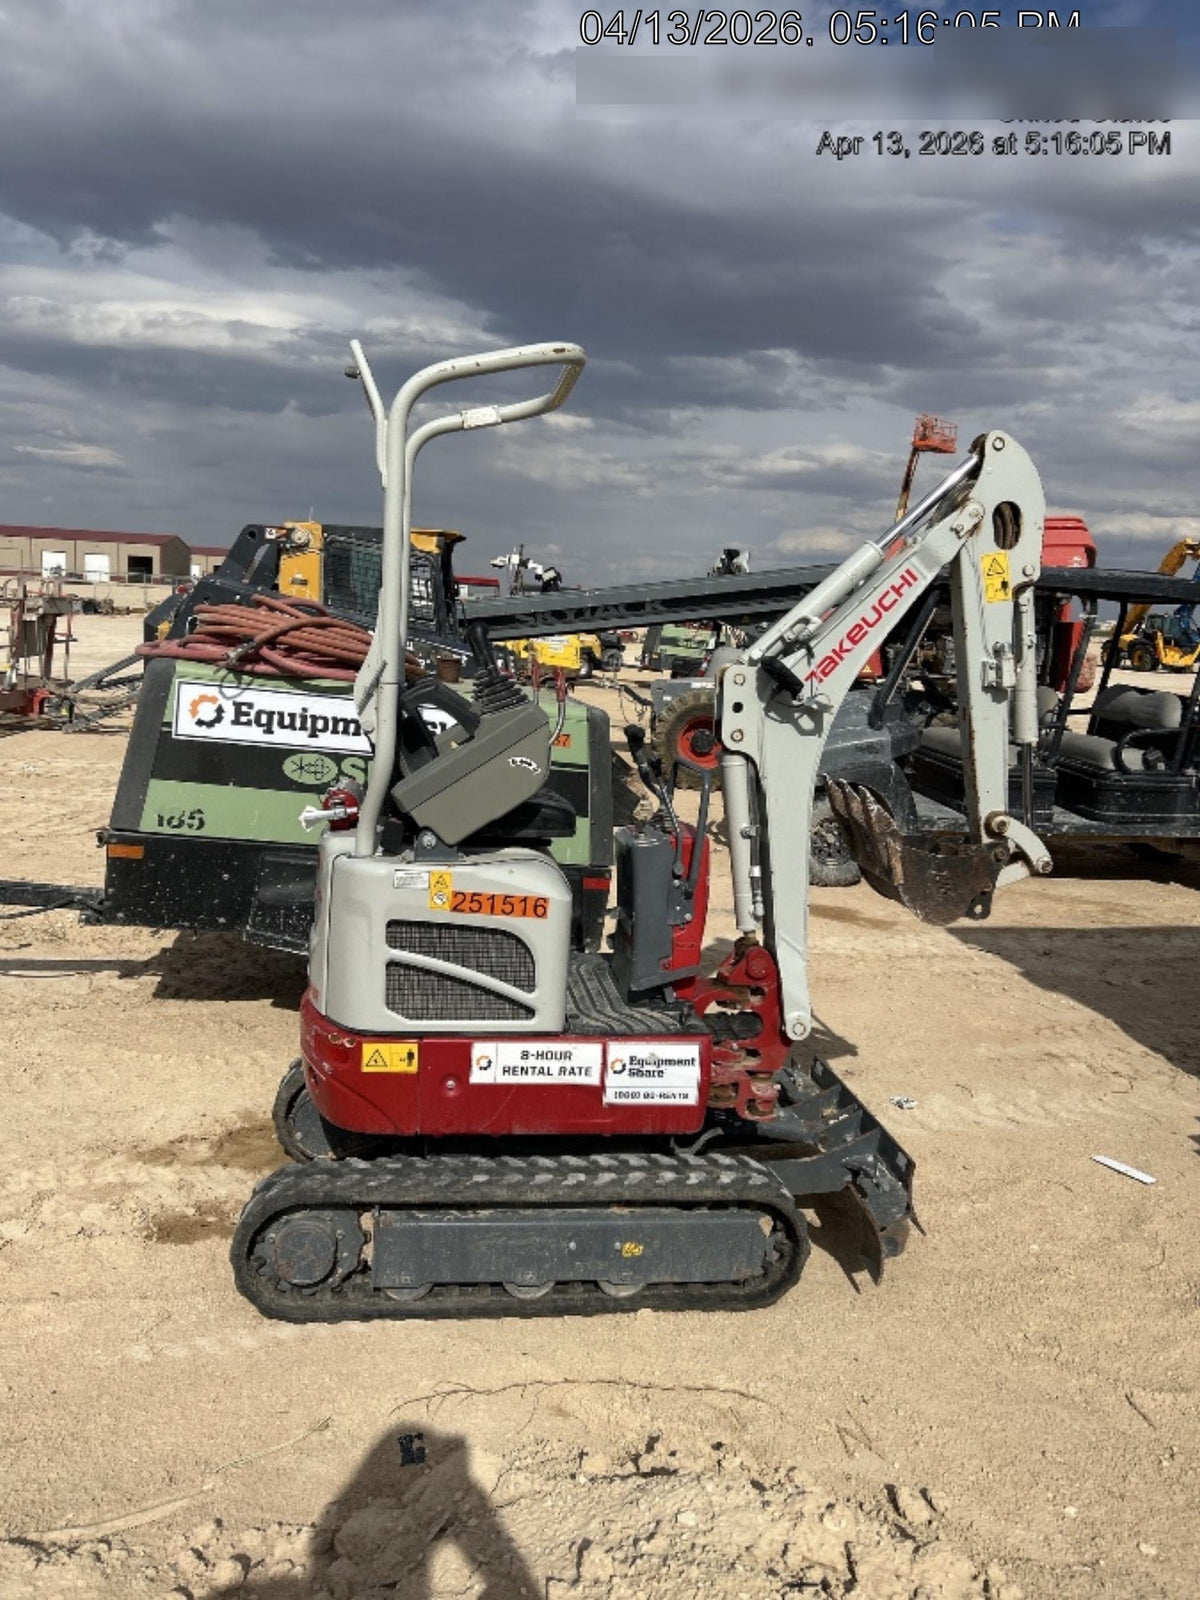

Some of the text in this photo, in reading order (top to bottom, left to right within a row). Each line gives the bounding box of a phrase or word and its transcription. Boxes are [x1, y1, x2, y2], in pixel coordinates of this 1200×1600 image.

[452, 891, 548, 918] 251516
[520, 1050, 573, 1061] 8-HOUR
[628, 1055, 696, 1068] Equipment
[502, 1065, 592, 1077] RENTAL RATE
[628, 1068, 664, 1078] Share
